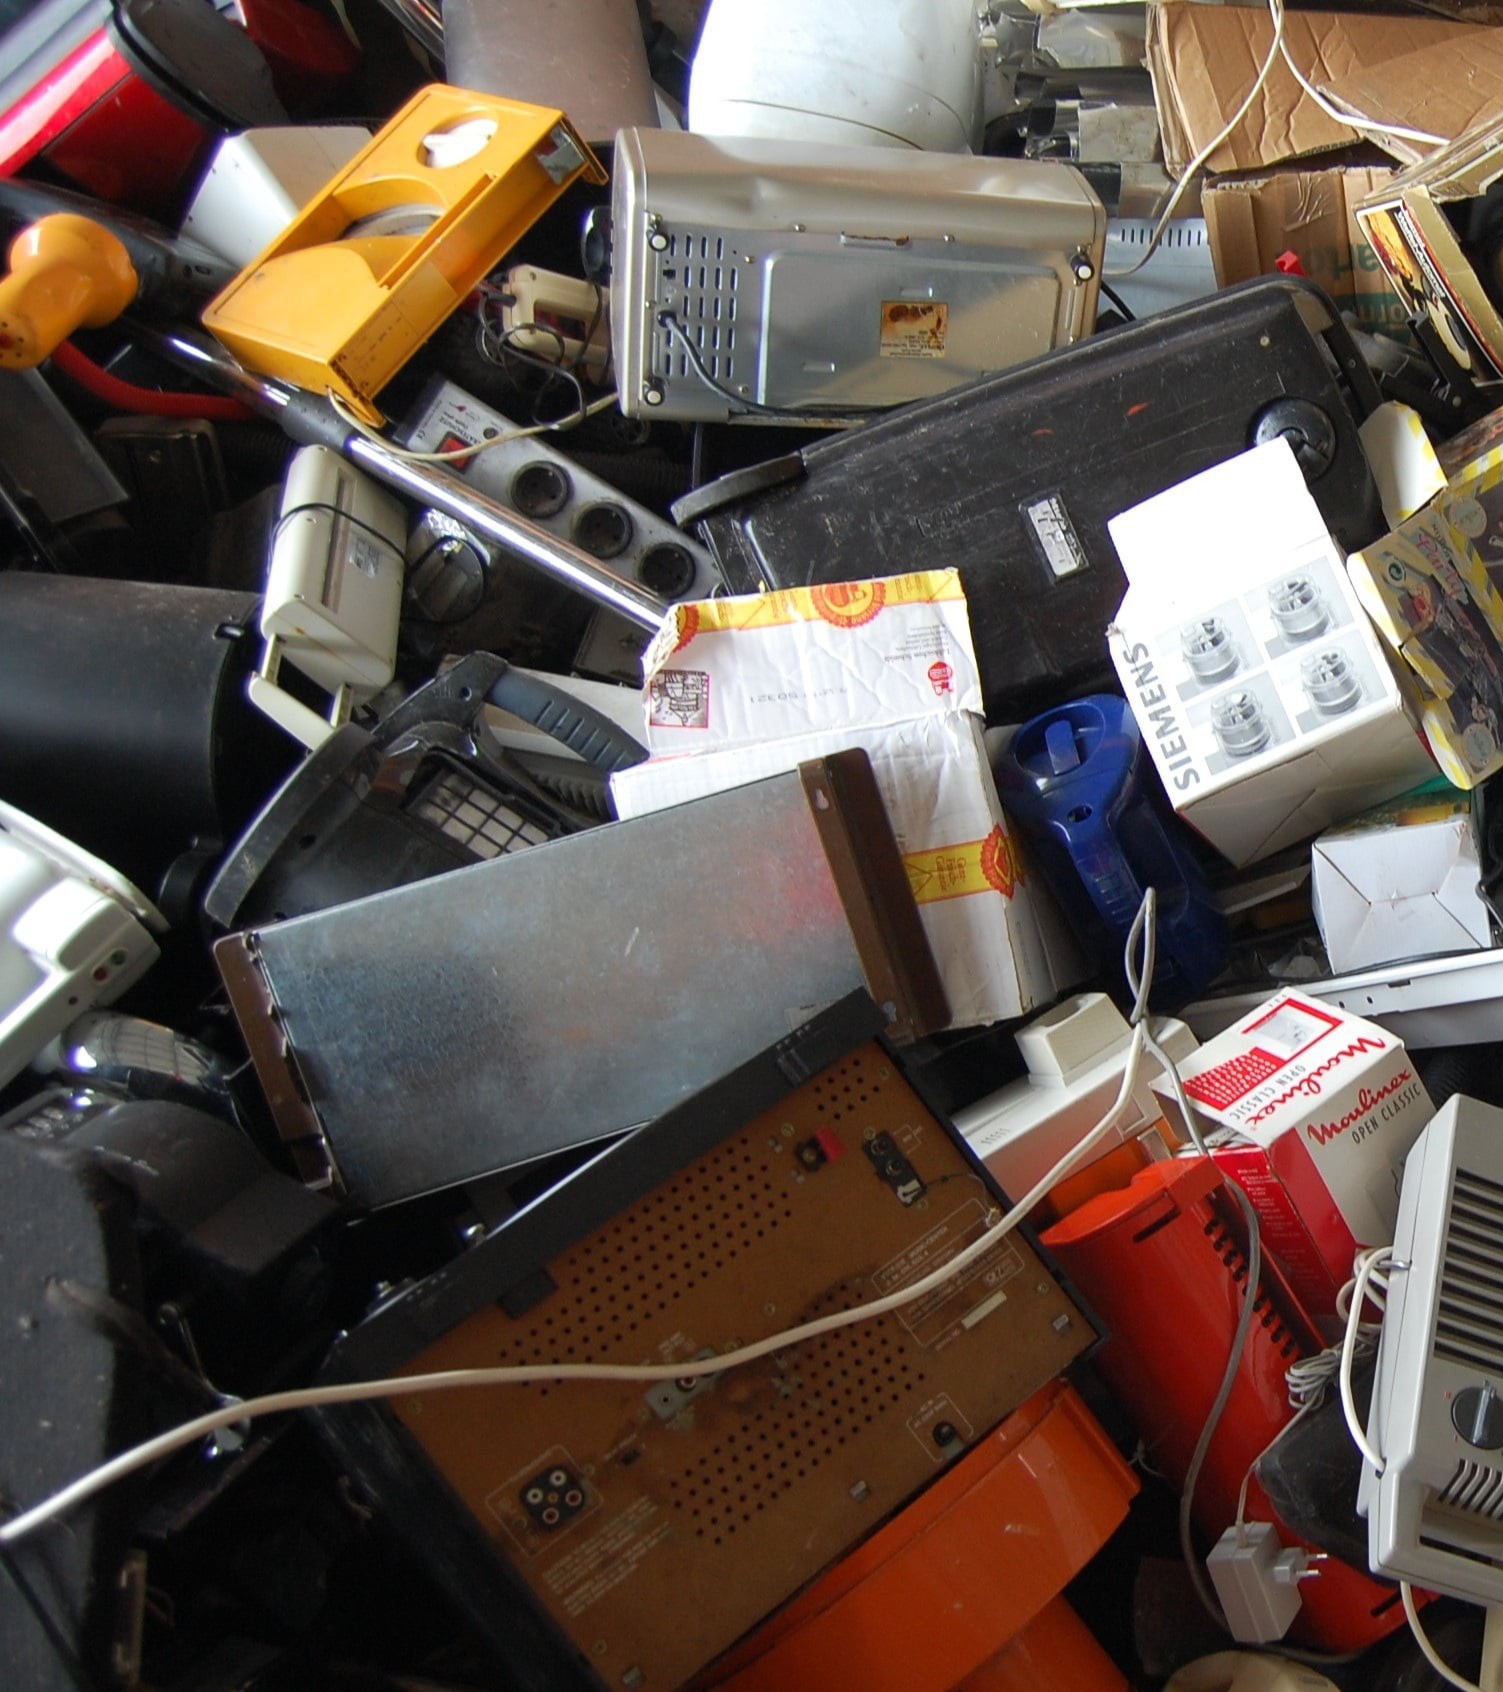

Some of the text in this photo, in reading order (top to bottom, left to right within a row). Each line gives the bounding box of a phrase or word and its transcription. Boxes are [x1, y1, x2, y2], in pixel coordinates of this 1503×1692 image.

[1122, 643, 1201, 791] SIEMENS
[1229, 1064, 1306, 1121] OPEN CLASSIC
[1245, 1037, 1387, 1125] Moulinex
[1307, 1069, 1412, 1146] Moulinex
[1351, 1082, 1422, 1145] OPEN CLASSIC
